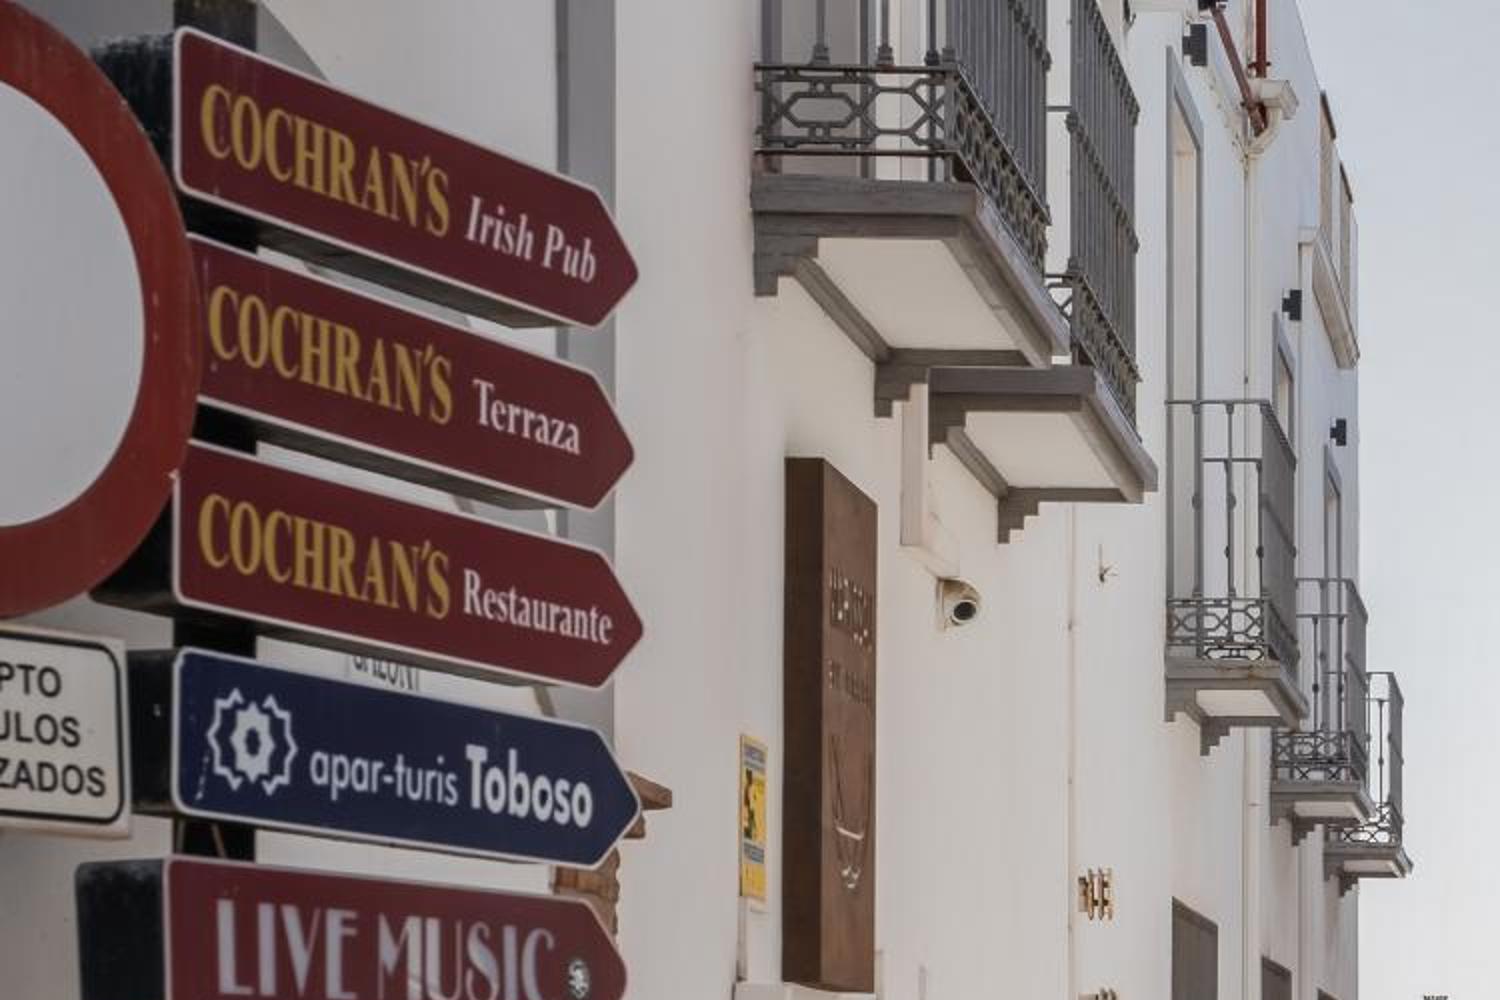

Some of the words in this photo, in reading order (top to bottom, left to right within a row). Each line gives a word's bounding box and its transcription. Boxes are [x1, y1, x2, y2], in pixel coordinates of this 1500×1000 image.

[202, 84, 450, 238] COCHRAN'S
[465, 196, 533, 260] Irish
[543, 224, 597, 284] Pub
[209, 286, 454, 425] COCHRAN'S
[473, 378, 580, 456] Terraza
[199, 494, 450, 620] COCHRAN'S
[464, 568, 613, 646] Restaurante
[310, 748, 458, 807] apar-turis
[466, 744, 593, 829] Toboso
[217, 898, 359, 1000] LIVE
